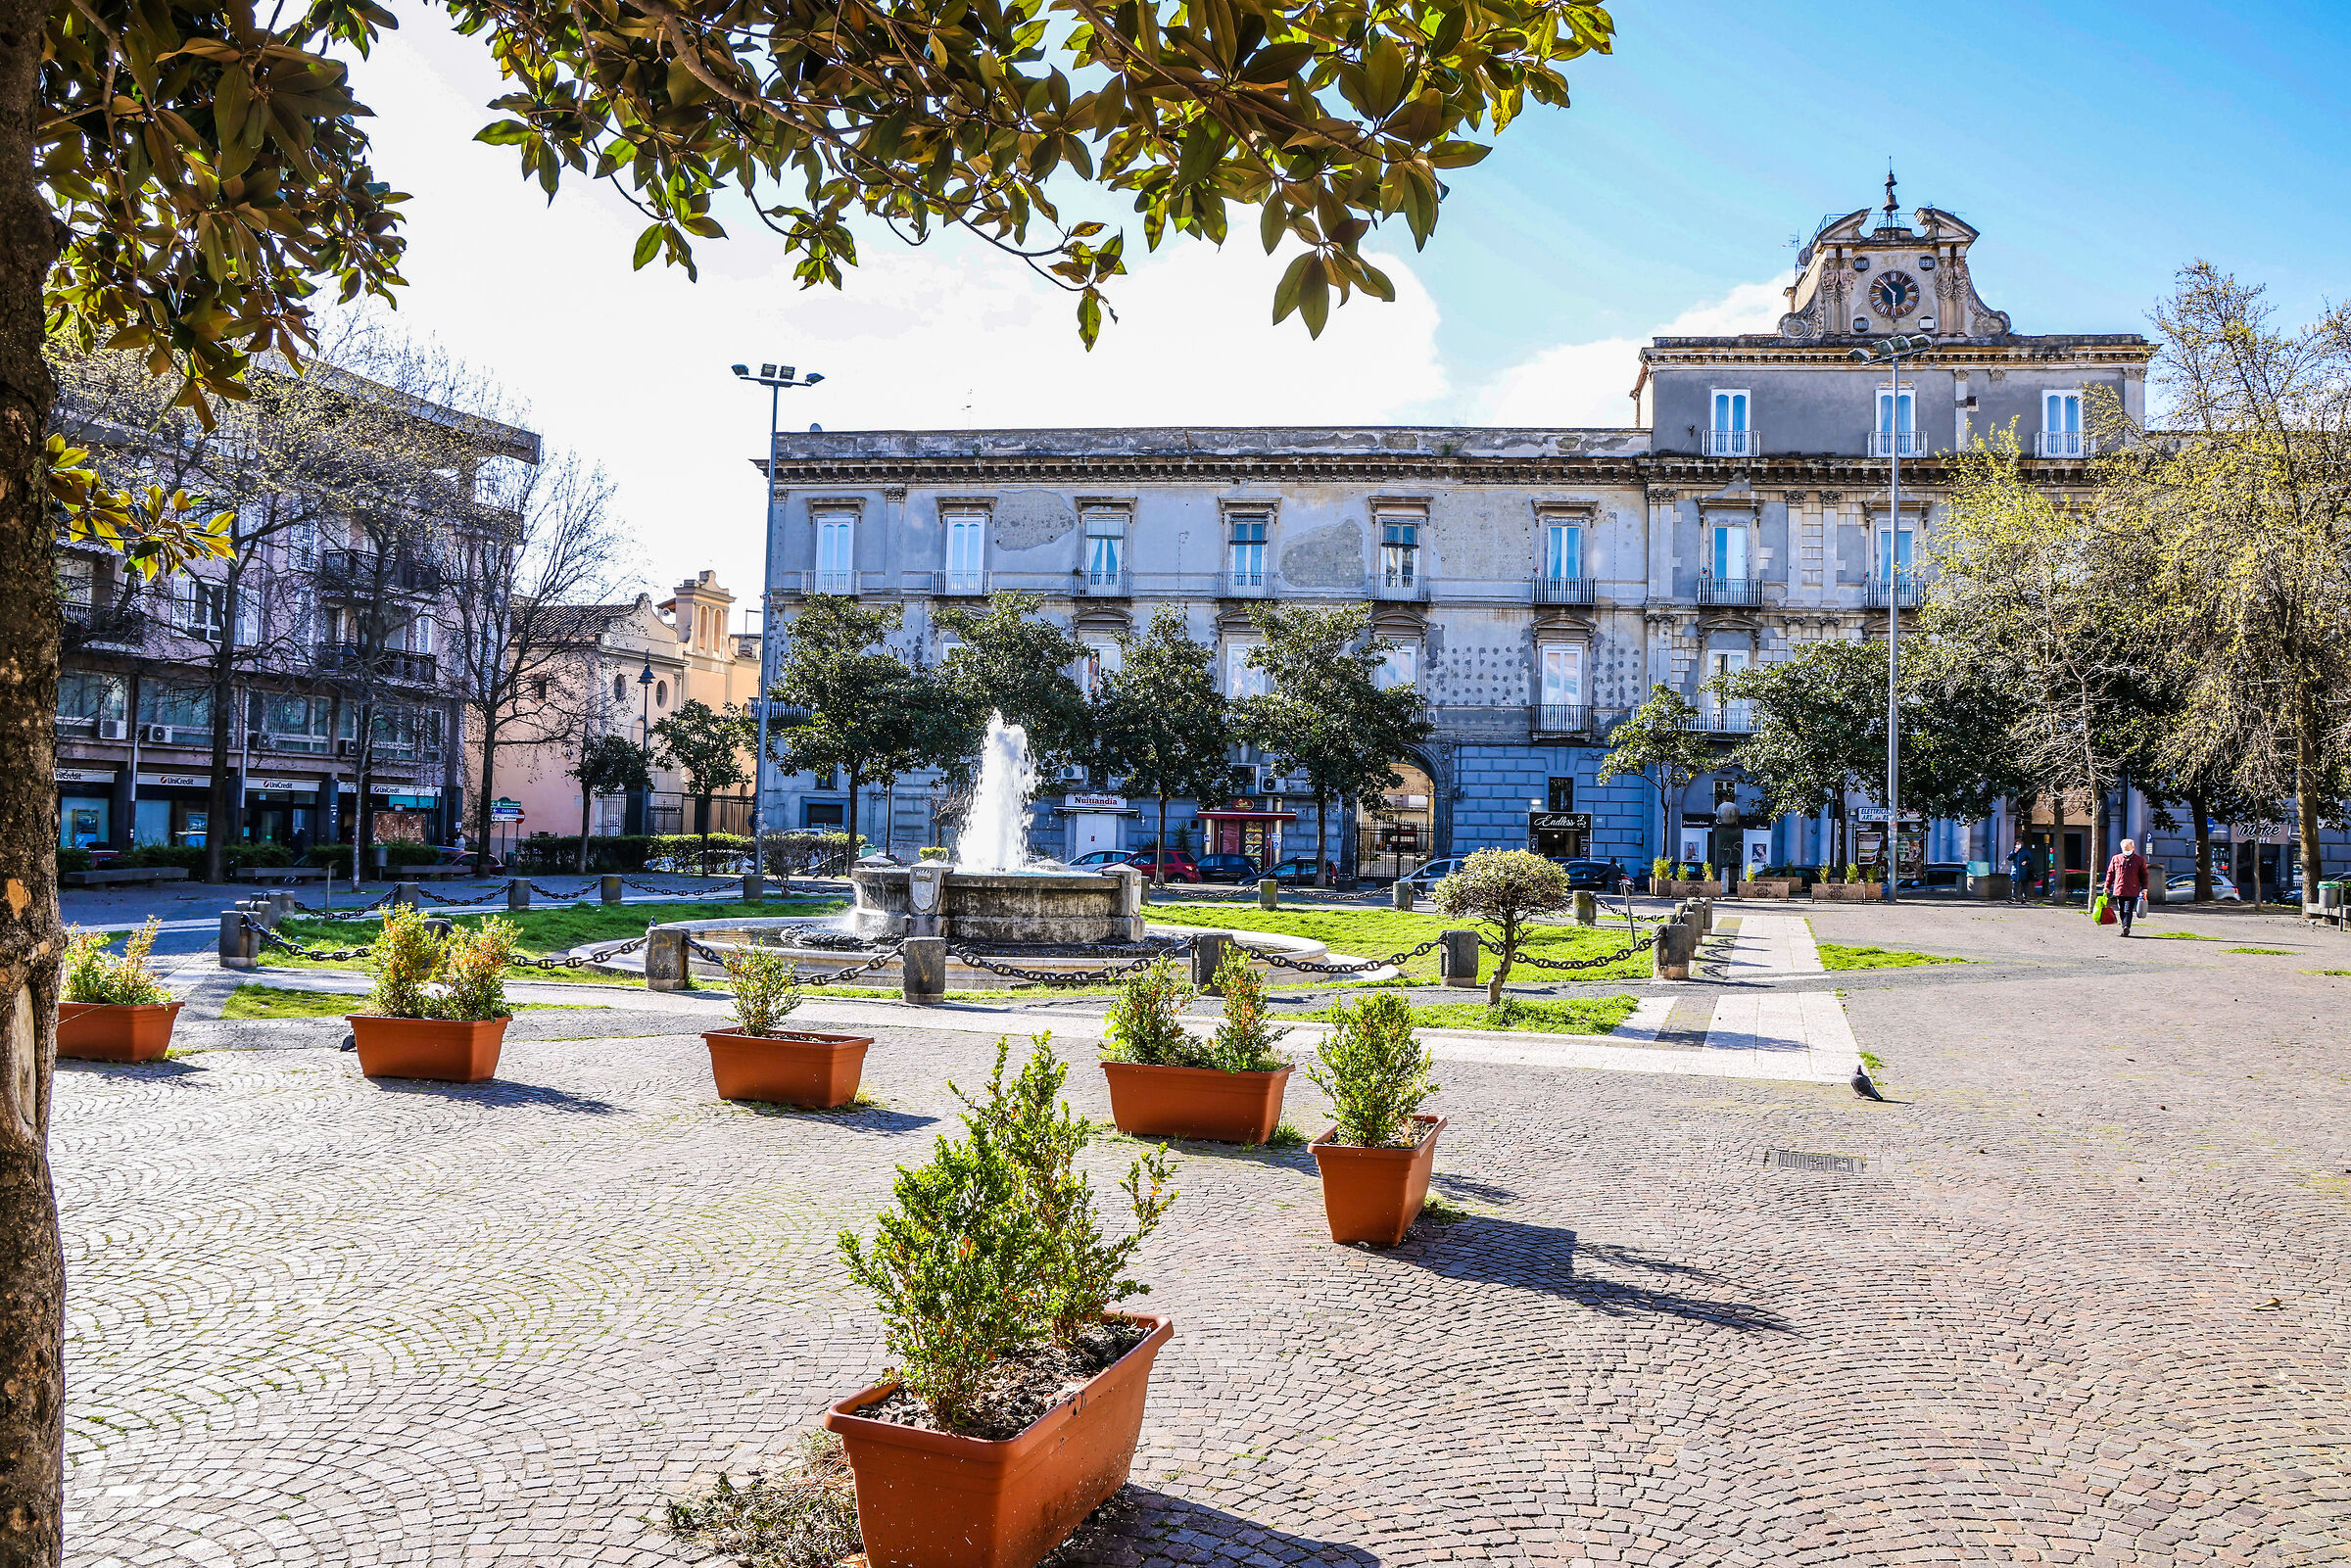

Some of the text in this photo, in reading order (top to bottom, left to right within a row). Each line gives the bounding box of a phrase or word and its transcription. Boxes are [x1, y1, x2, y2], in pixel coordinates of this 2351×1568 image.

[168, 777, 194, 787] UniCredit
[269, 780, 293, 789] UniCredit
[379, 785, 400, 794] UniCredit
[1534, 814, 1575, 827] Endless
